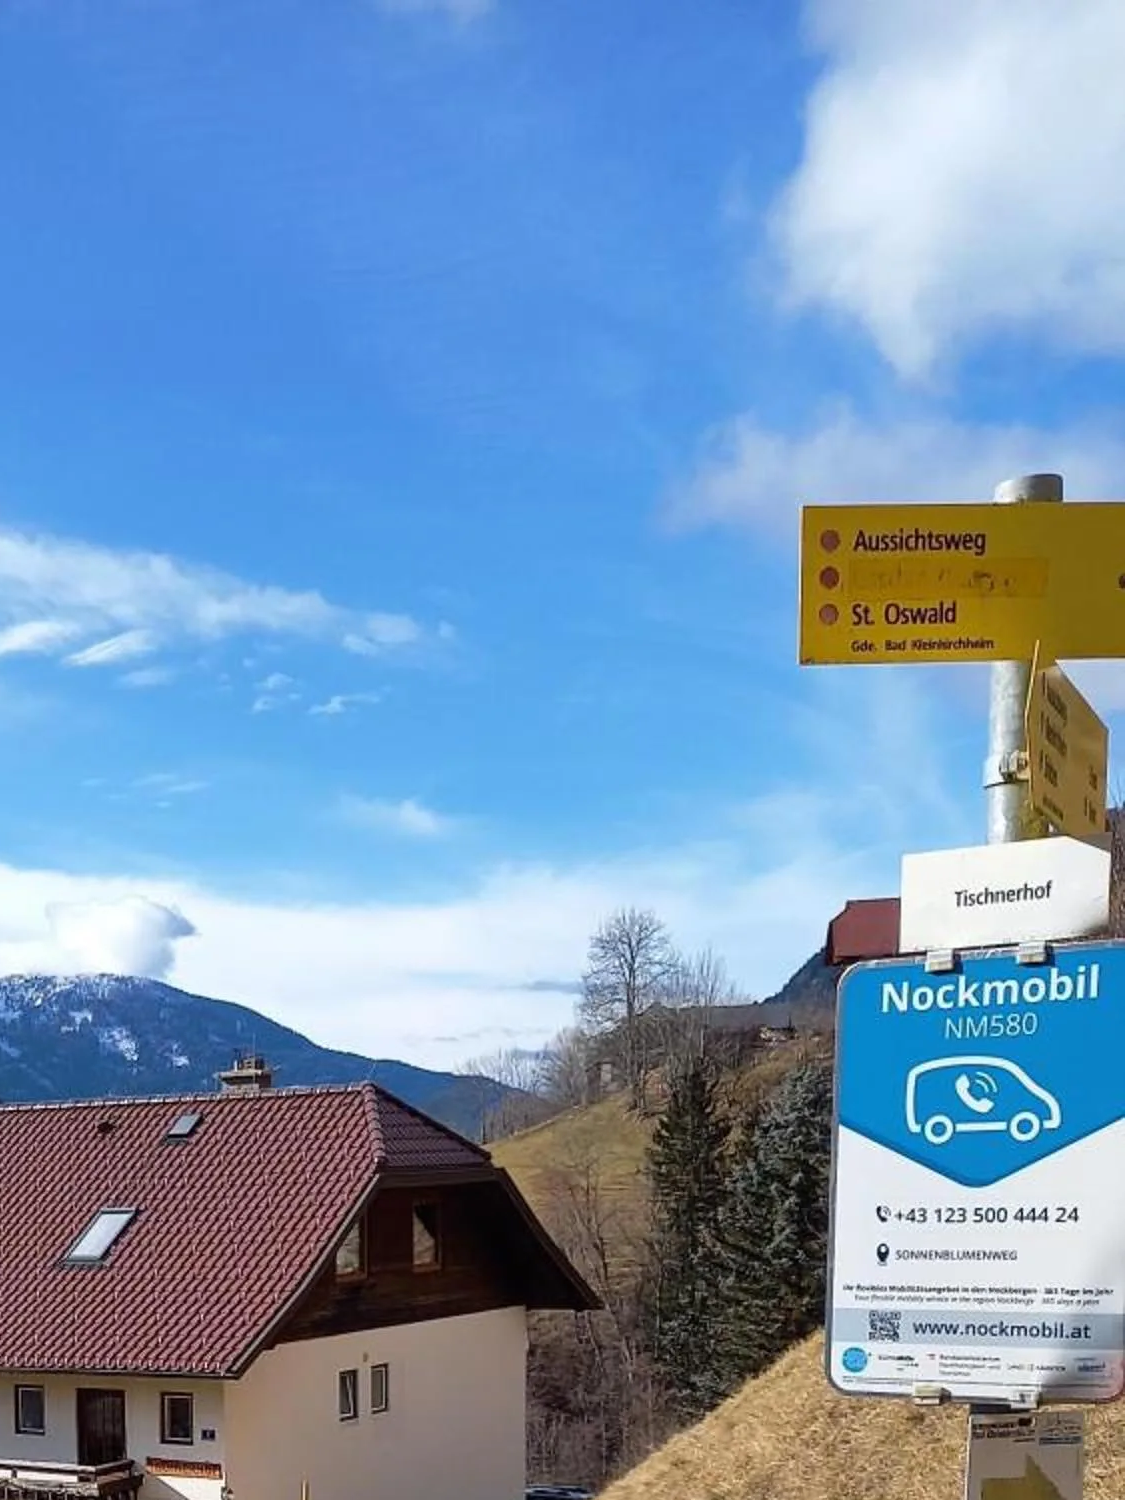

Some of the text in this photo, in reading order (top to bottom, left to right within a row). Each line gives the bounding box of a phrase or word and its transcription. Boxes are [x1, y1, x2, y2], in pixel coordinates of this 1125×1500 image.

[853, 528, 987, 555] Aussichtsweg
[851, 601, 957, 626] St. Oswald
[851, 637, 995, 653] Gde. Bad Kleinkirchheim
[954, 880, 1053, 908] Tischnerhof
[881, 963, 1101, 1013] Nockmobil
[944, 1012, 1039, 1040] NM580
[895, 1206, 1080, 1223] +43 123 500 444 24
[895, 1249, 1018, 1261] SONNENBLUMENWEG
[912, 1320, 1092, 1339] www.nockmobil.at
